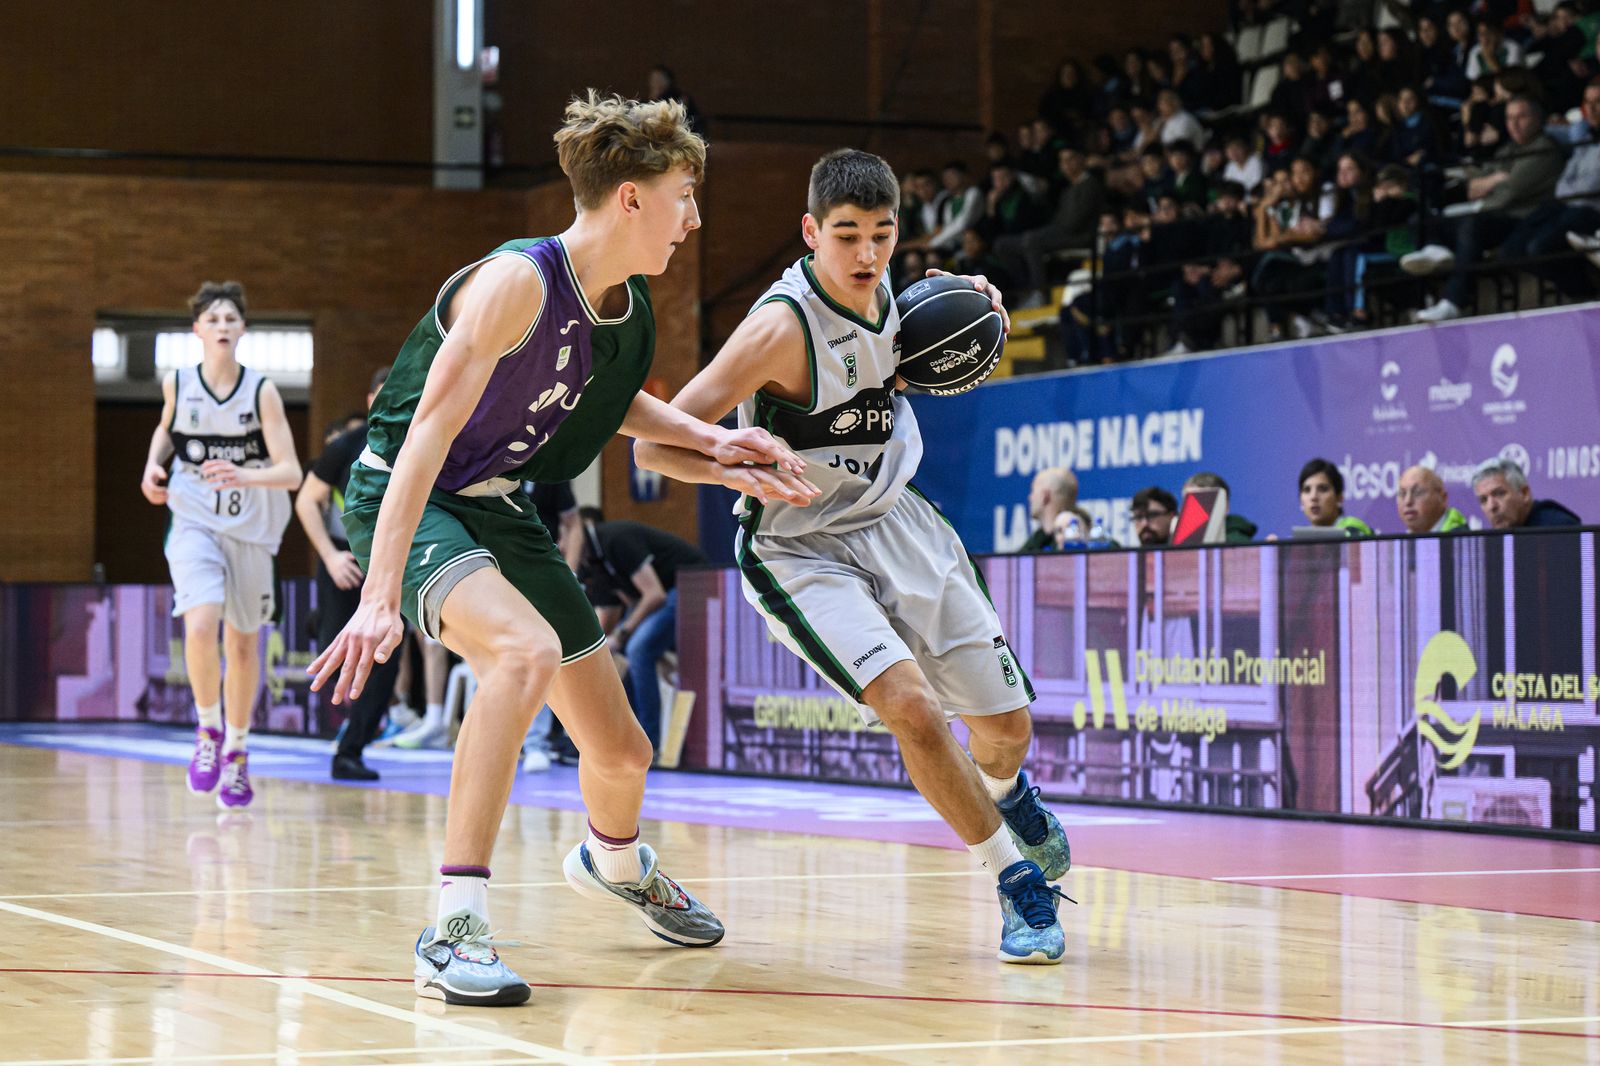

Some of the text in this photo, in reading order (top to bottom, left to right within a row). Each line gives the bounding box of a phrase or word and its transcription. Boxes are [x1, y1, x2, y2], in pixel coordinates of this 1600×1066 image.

[827, 330, 858, 349] SPALDING
[928, 353, 1000, 395] SPALDING
[866, 409, 894, 432] PR
[995, 408, 1204, 477] DONDE NACEN
[215, 490, 241, 516] 18
[852, 642, 887, 669] SPALDING
[1135, 648, 1326, 691] Diputación Provincial
[1492, 672, 1600, 700] COSTA DEL S
[1135, 698, 1227, 743] de Málaga
